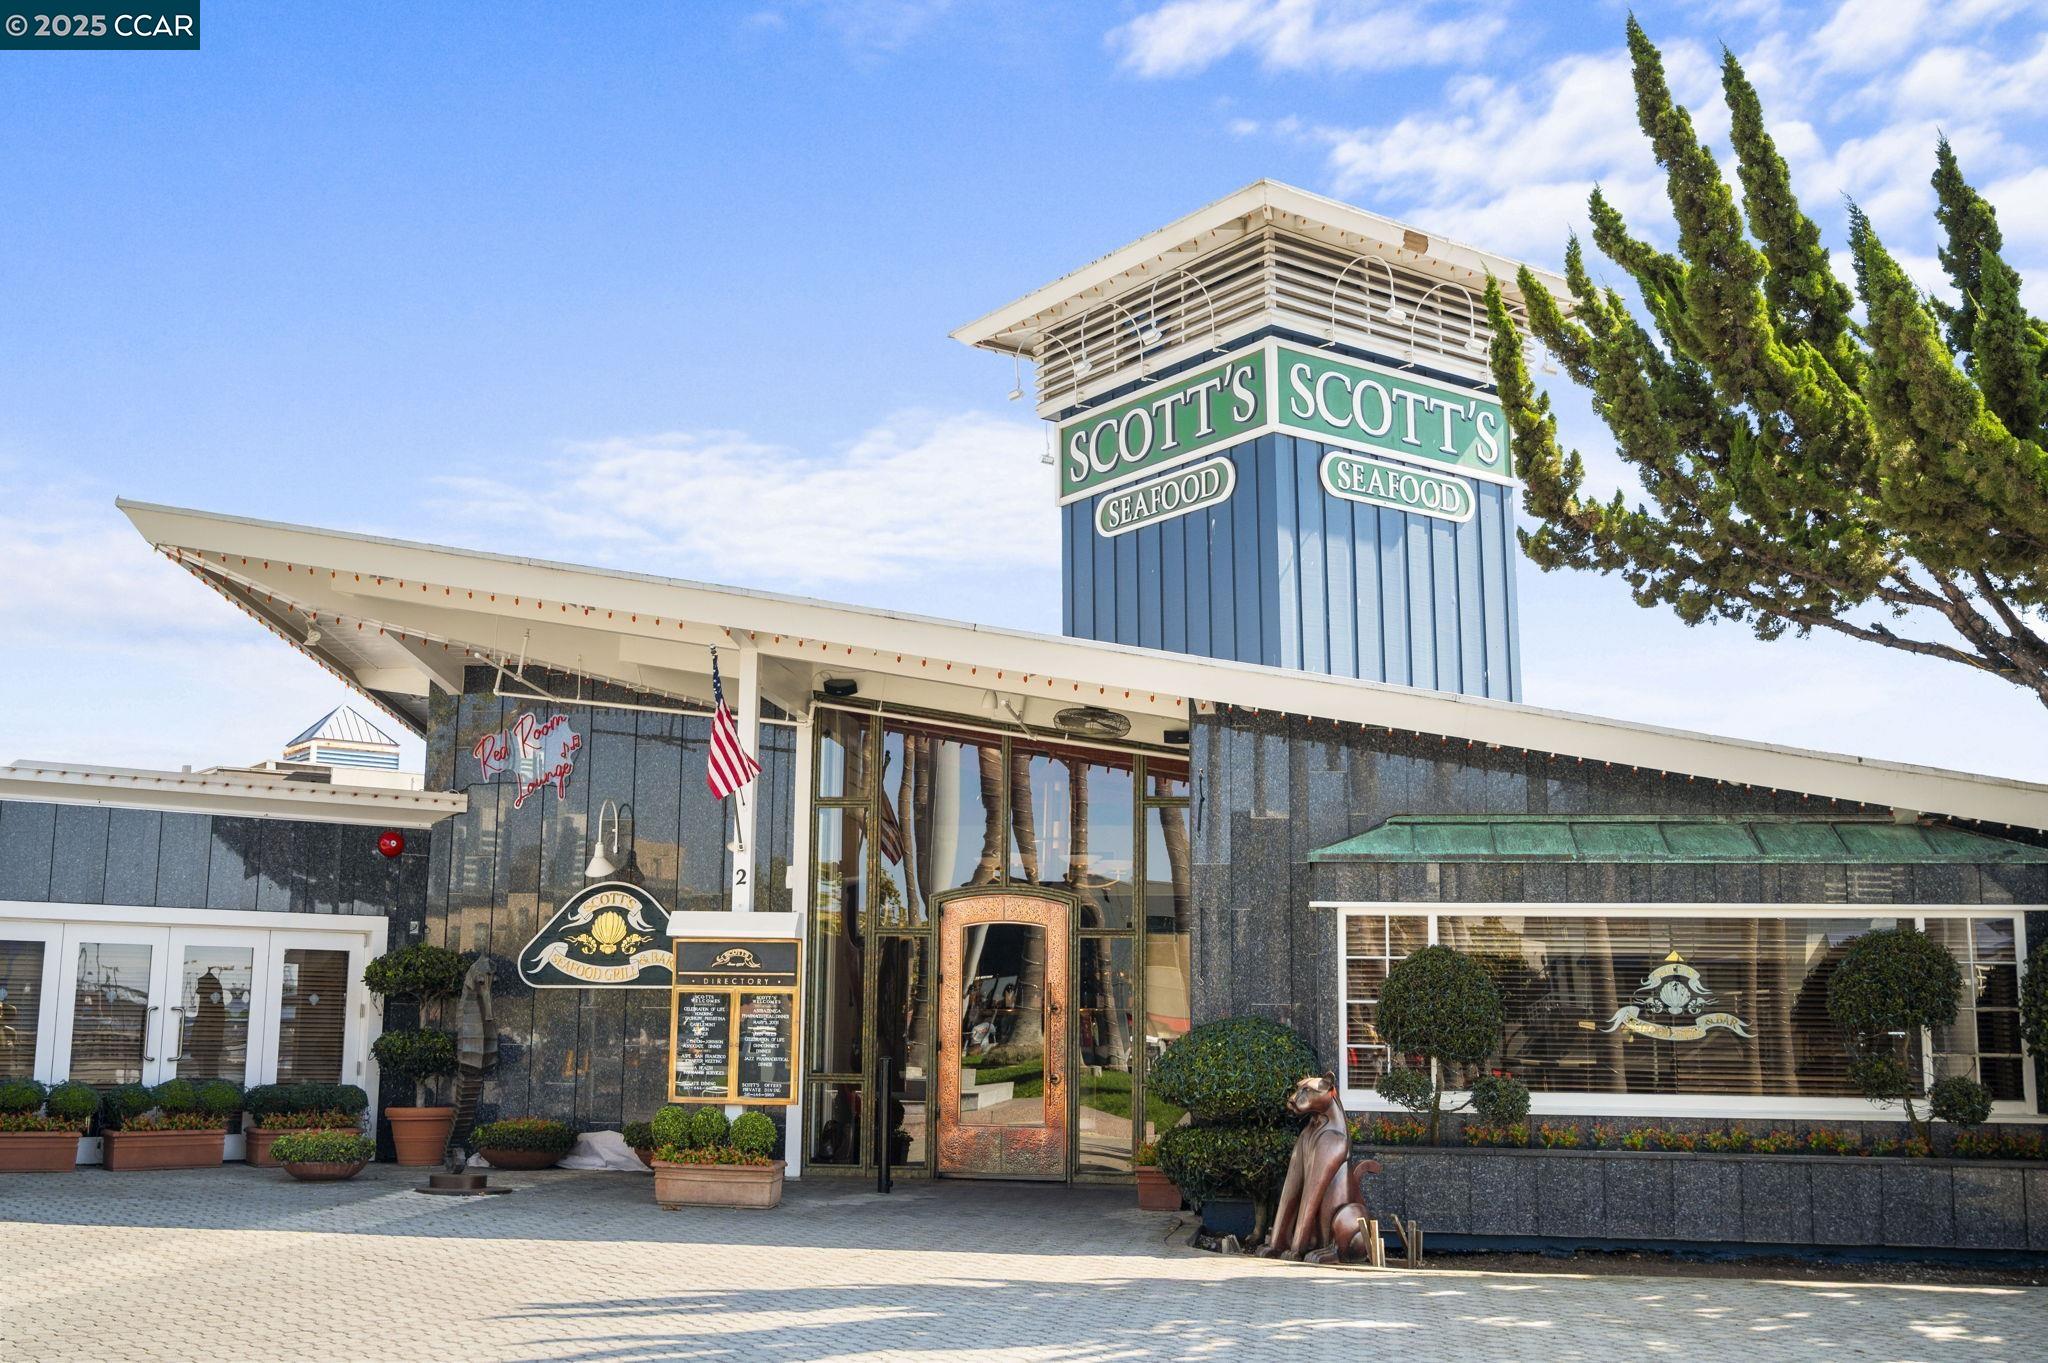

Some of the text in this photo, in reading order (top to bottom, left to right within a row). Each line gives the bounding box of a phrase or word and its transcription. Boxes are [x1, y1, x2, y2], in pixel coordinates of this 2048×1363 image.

[1070, 363, 1258, 483] SCOTT'S
[1290, 362, 1499, 465] SCOTT'S
[1108, 467, 1221, 529] SEAFOOD
[1337, 461, 1462, 512] SEAFOOD
[474, 713, 567, 781] Red Room
[514, 762, 573, 808] Lounge
[583, 892, 638, 913] SCOTT'S
[736, 868, 747, 886] 2
[550, 953, 602, 981] SEAFOOD
[604, 966, 639, 981] GRILL
